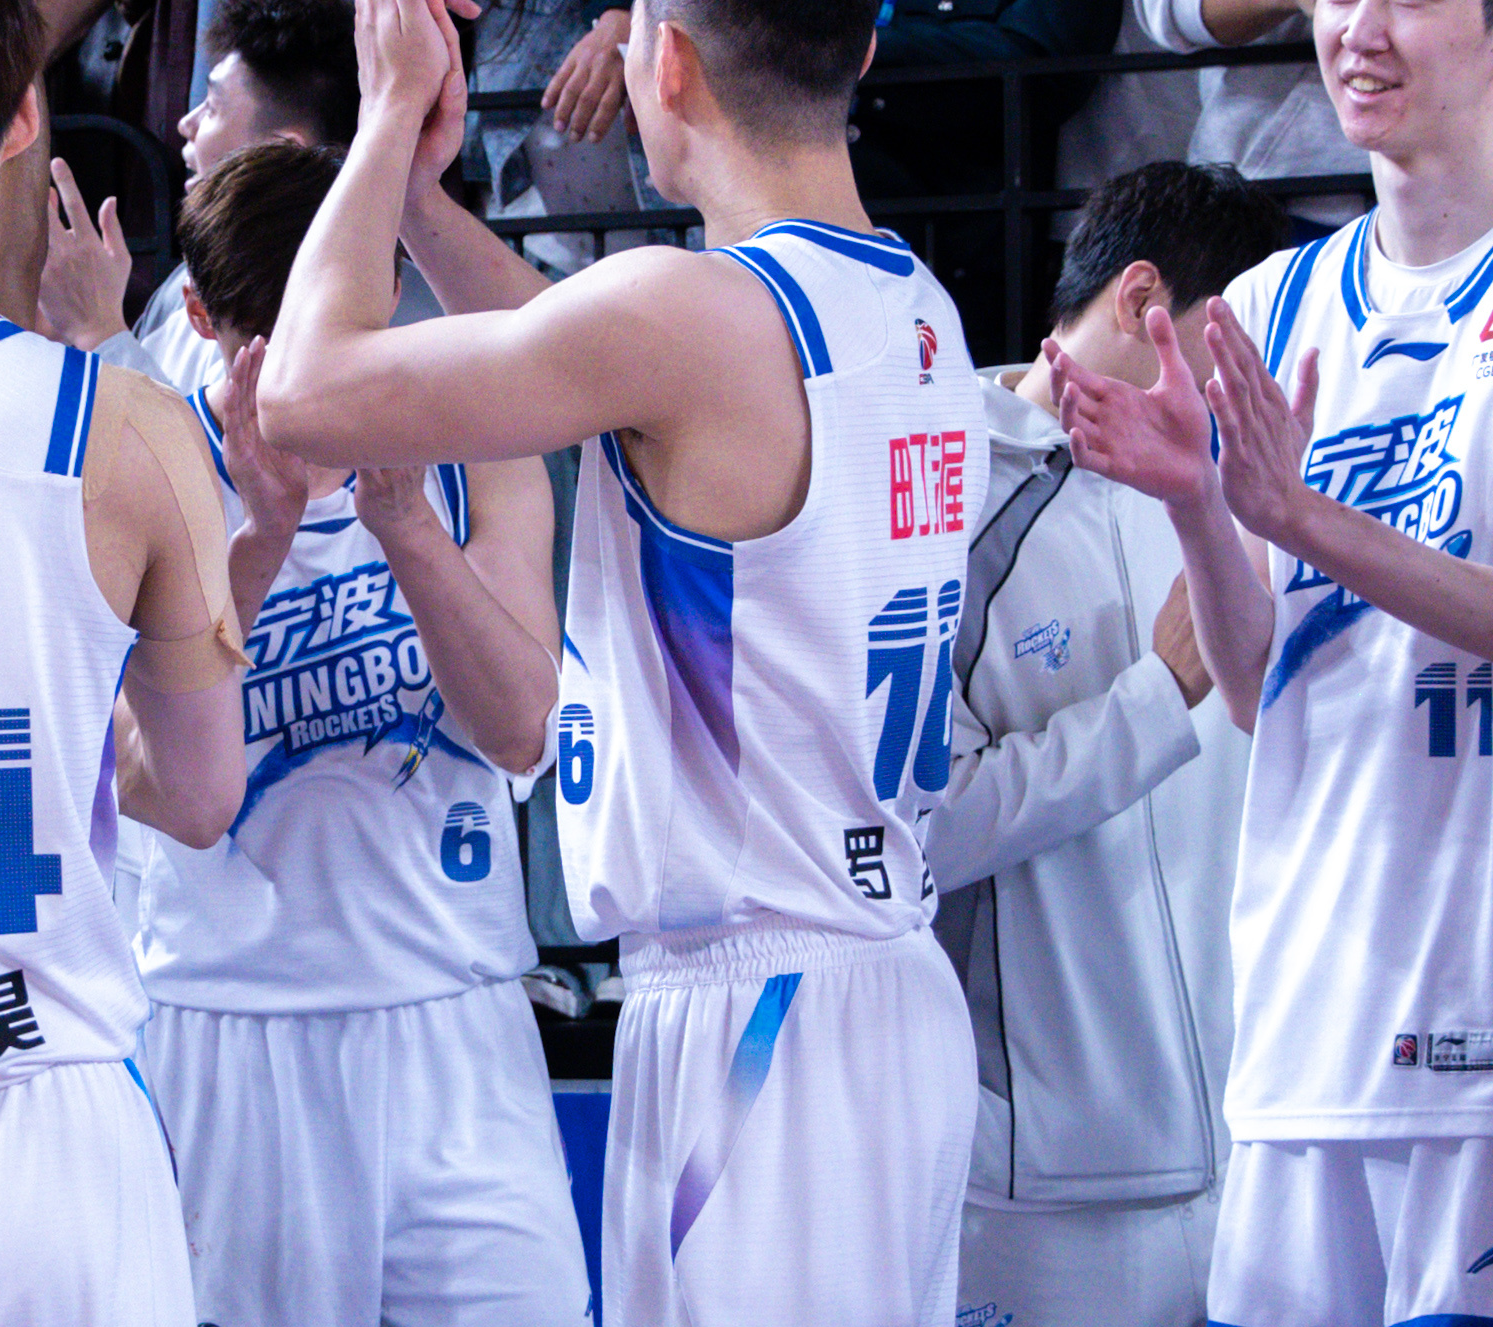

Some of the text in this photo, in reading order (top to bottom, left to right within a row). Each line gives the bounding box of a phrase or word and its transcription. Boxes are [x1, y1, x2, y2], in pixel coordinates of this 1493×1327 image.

[889, 430, 966, 540] 町渥
[248, 633, 431, 737] NINGBO
[290, 695, 398, 751] ROCKETS
[1414, 662, 1493, 757] 11
[440, 800, 492, 883] 6
